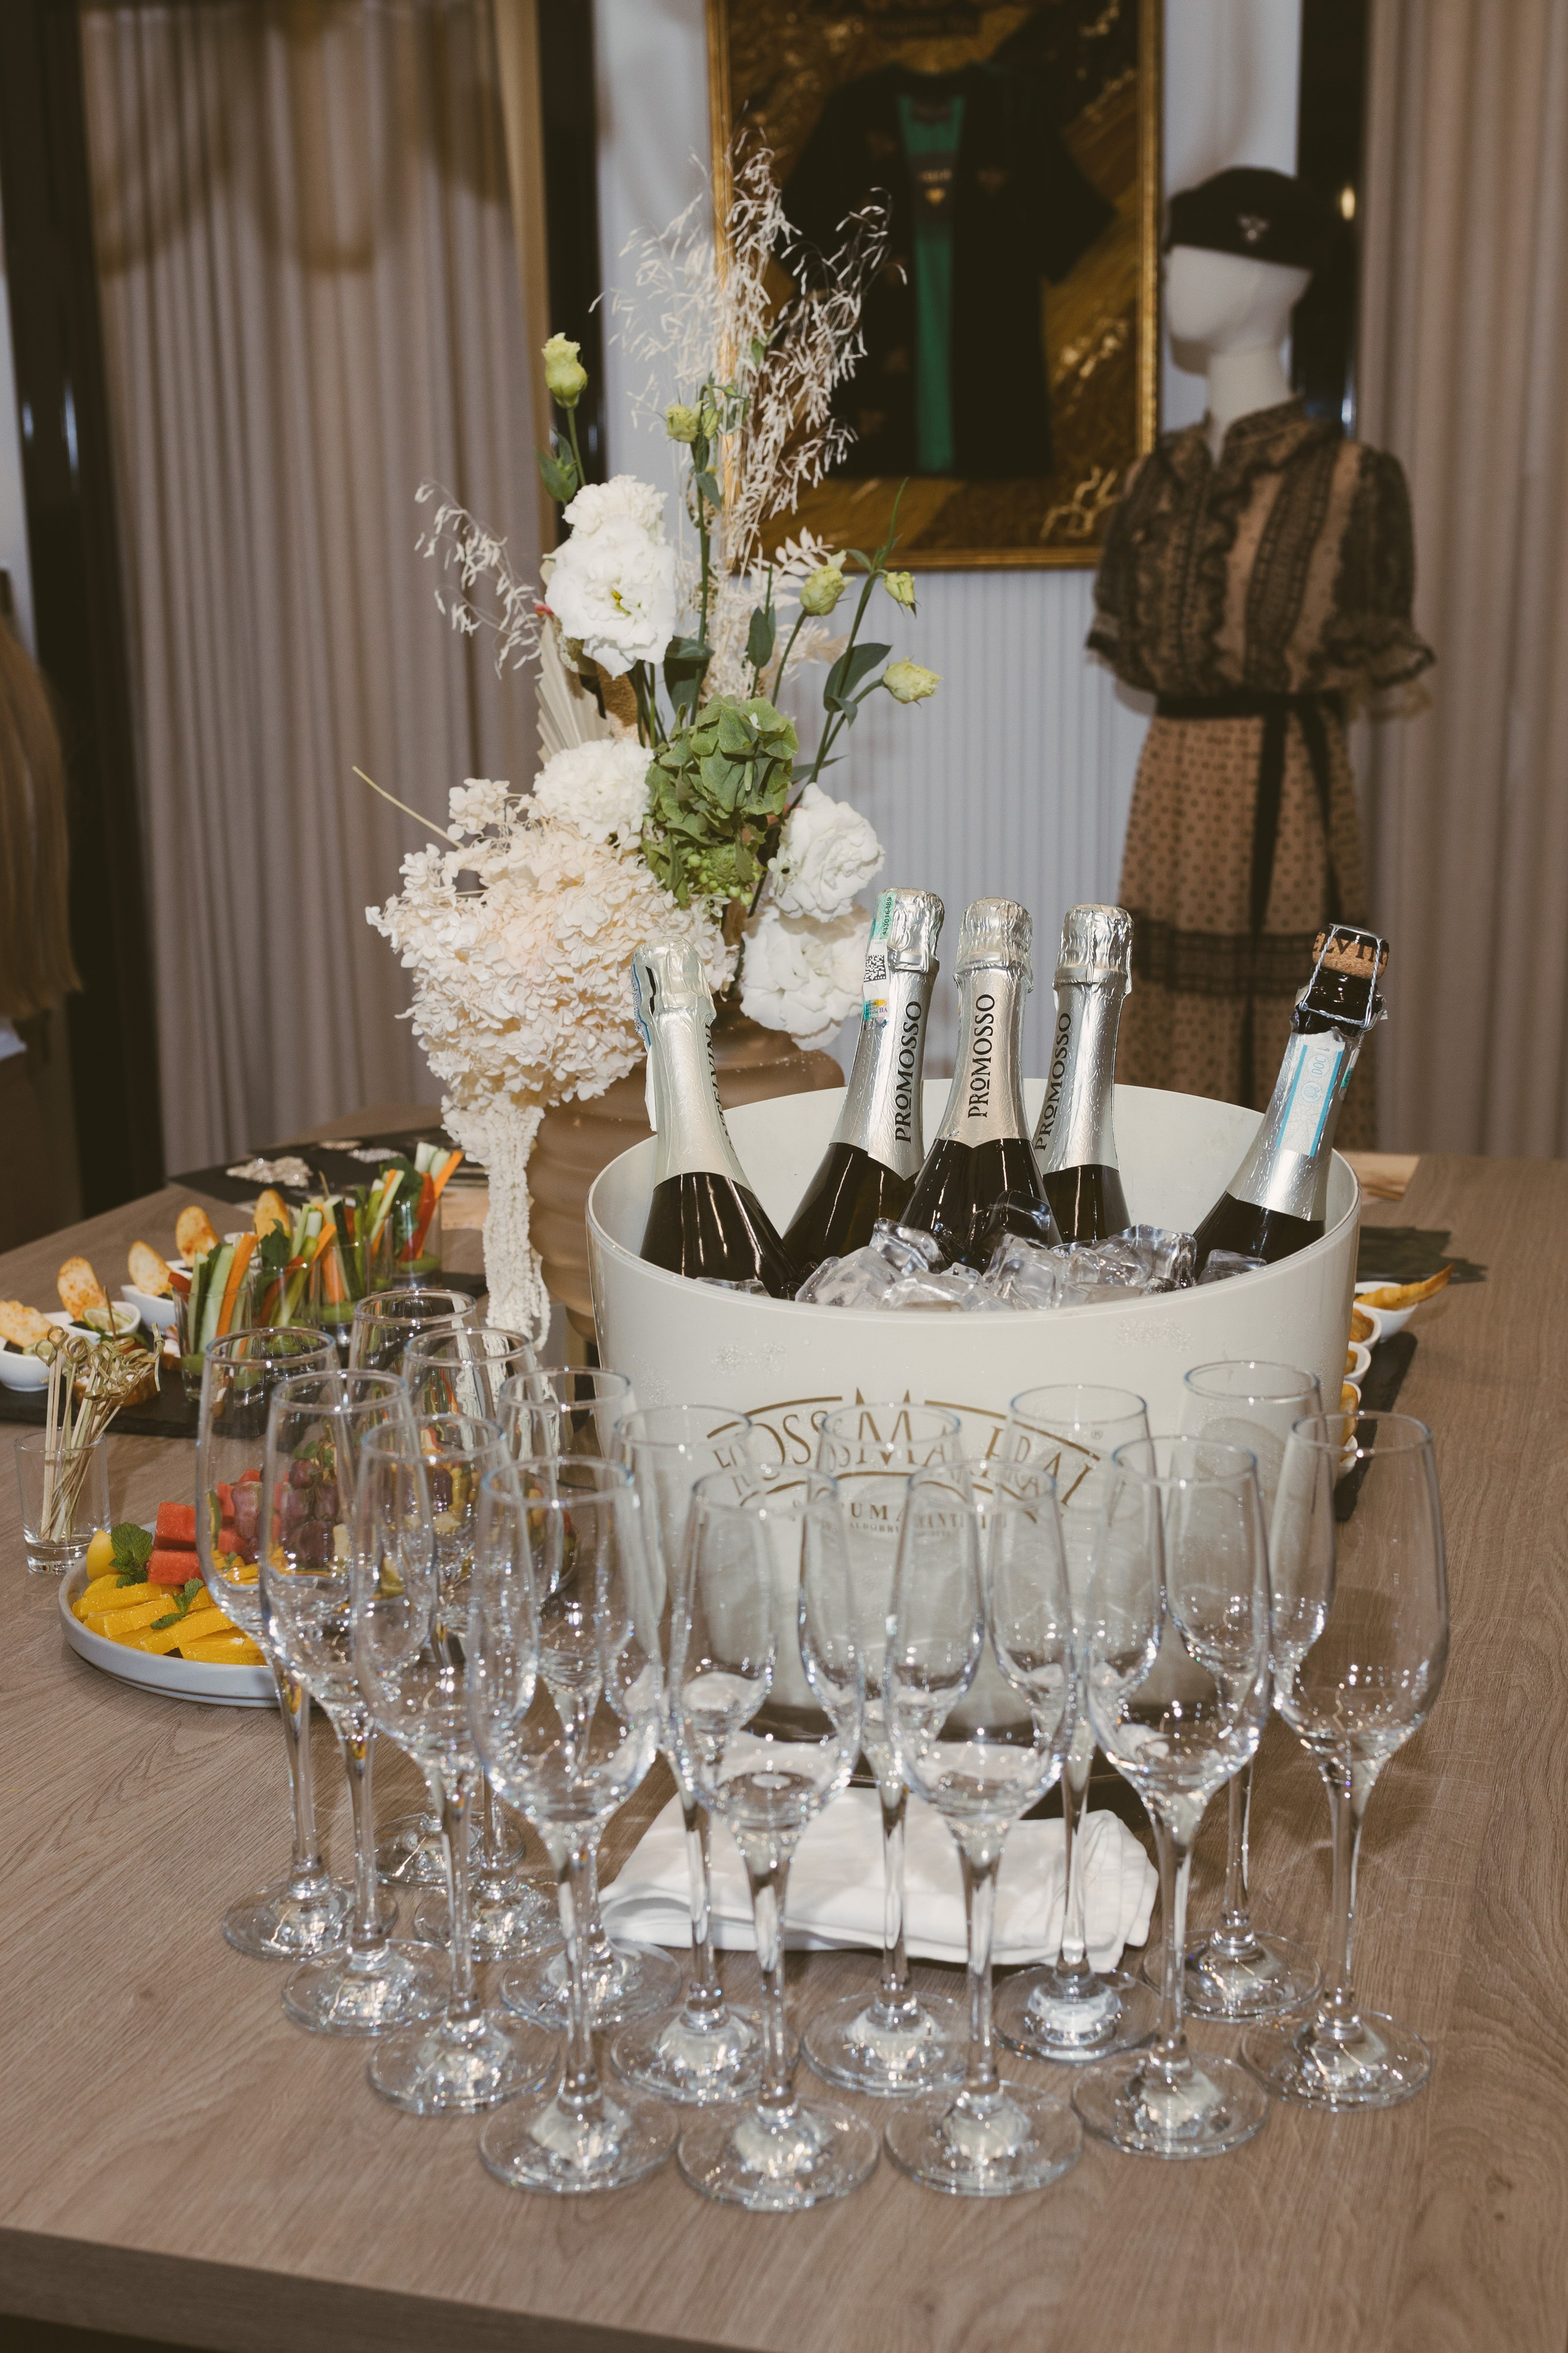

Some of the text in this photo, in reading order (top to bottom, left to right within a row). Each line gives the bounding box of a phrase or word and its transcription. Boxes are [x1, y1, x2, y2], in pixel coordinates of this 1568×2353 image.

[894, 1001, 922, 1144] PROMOSSO
[968, 994, 995, 1119] PROMOSSO
[1034, 1013, 1071, 1151] PROMOSSO
[1311, 1056, 1327, 1076] DOC
